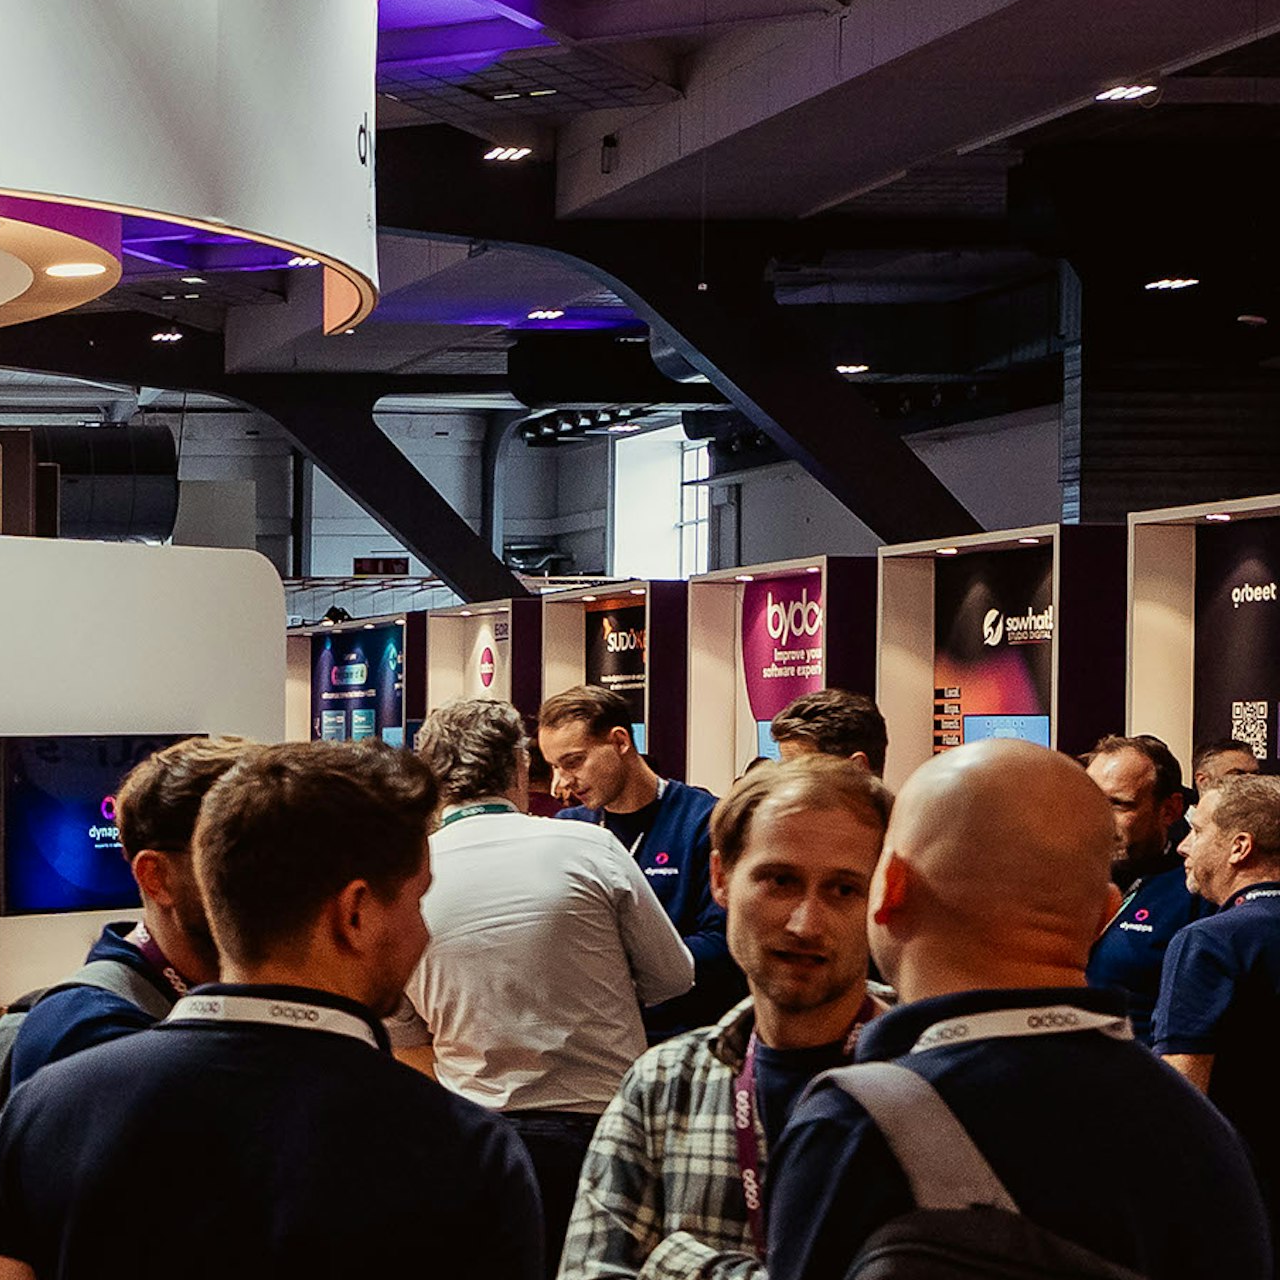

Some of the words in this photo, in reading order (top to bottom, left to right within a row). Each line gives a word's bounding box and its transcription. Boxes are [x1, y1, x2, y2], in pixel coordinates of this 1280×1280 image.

[1005, 605, 1054, 632] sowhat!
[774, 648, 805, 665] Improve
[763, 663, 795, 678] software
[270, 1004, 321, 1023] odoo
[1026, 1012, 1078, 1029] odoo
[736, 1089, 751, 1130] odoo
[742, 1168, 760, 1211] odoo
